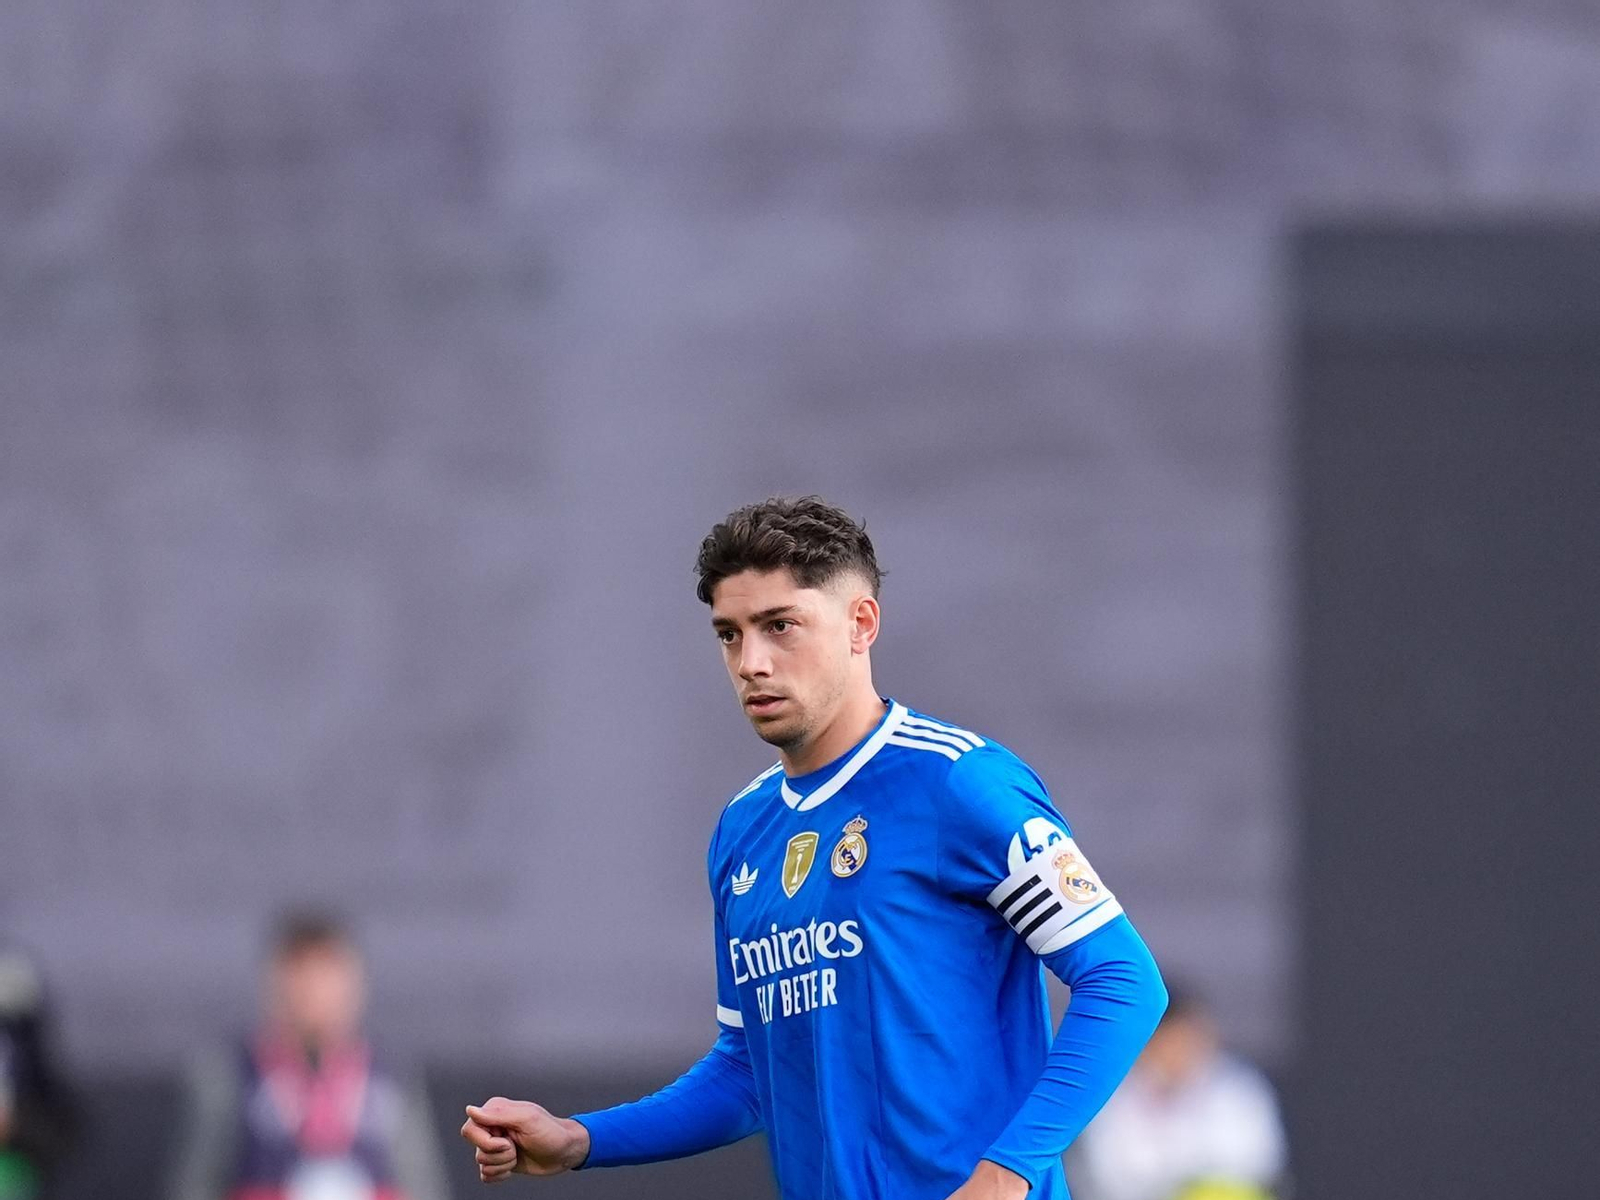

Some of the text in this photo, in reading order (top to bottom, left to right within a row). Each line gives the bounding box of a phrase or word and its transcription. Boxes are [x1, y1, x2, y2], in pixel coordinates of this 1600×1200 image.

[729, 916, 864, 986] Emirates
[756, 968, 838, 1025] FLY BETER
